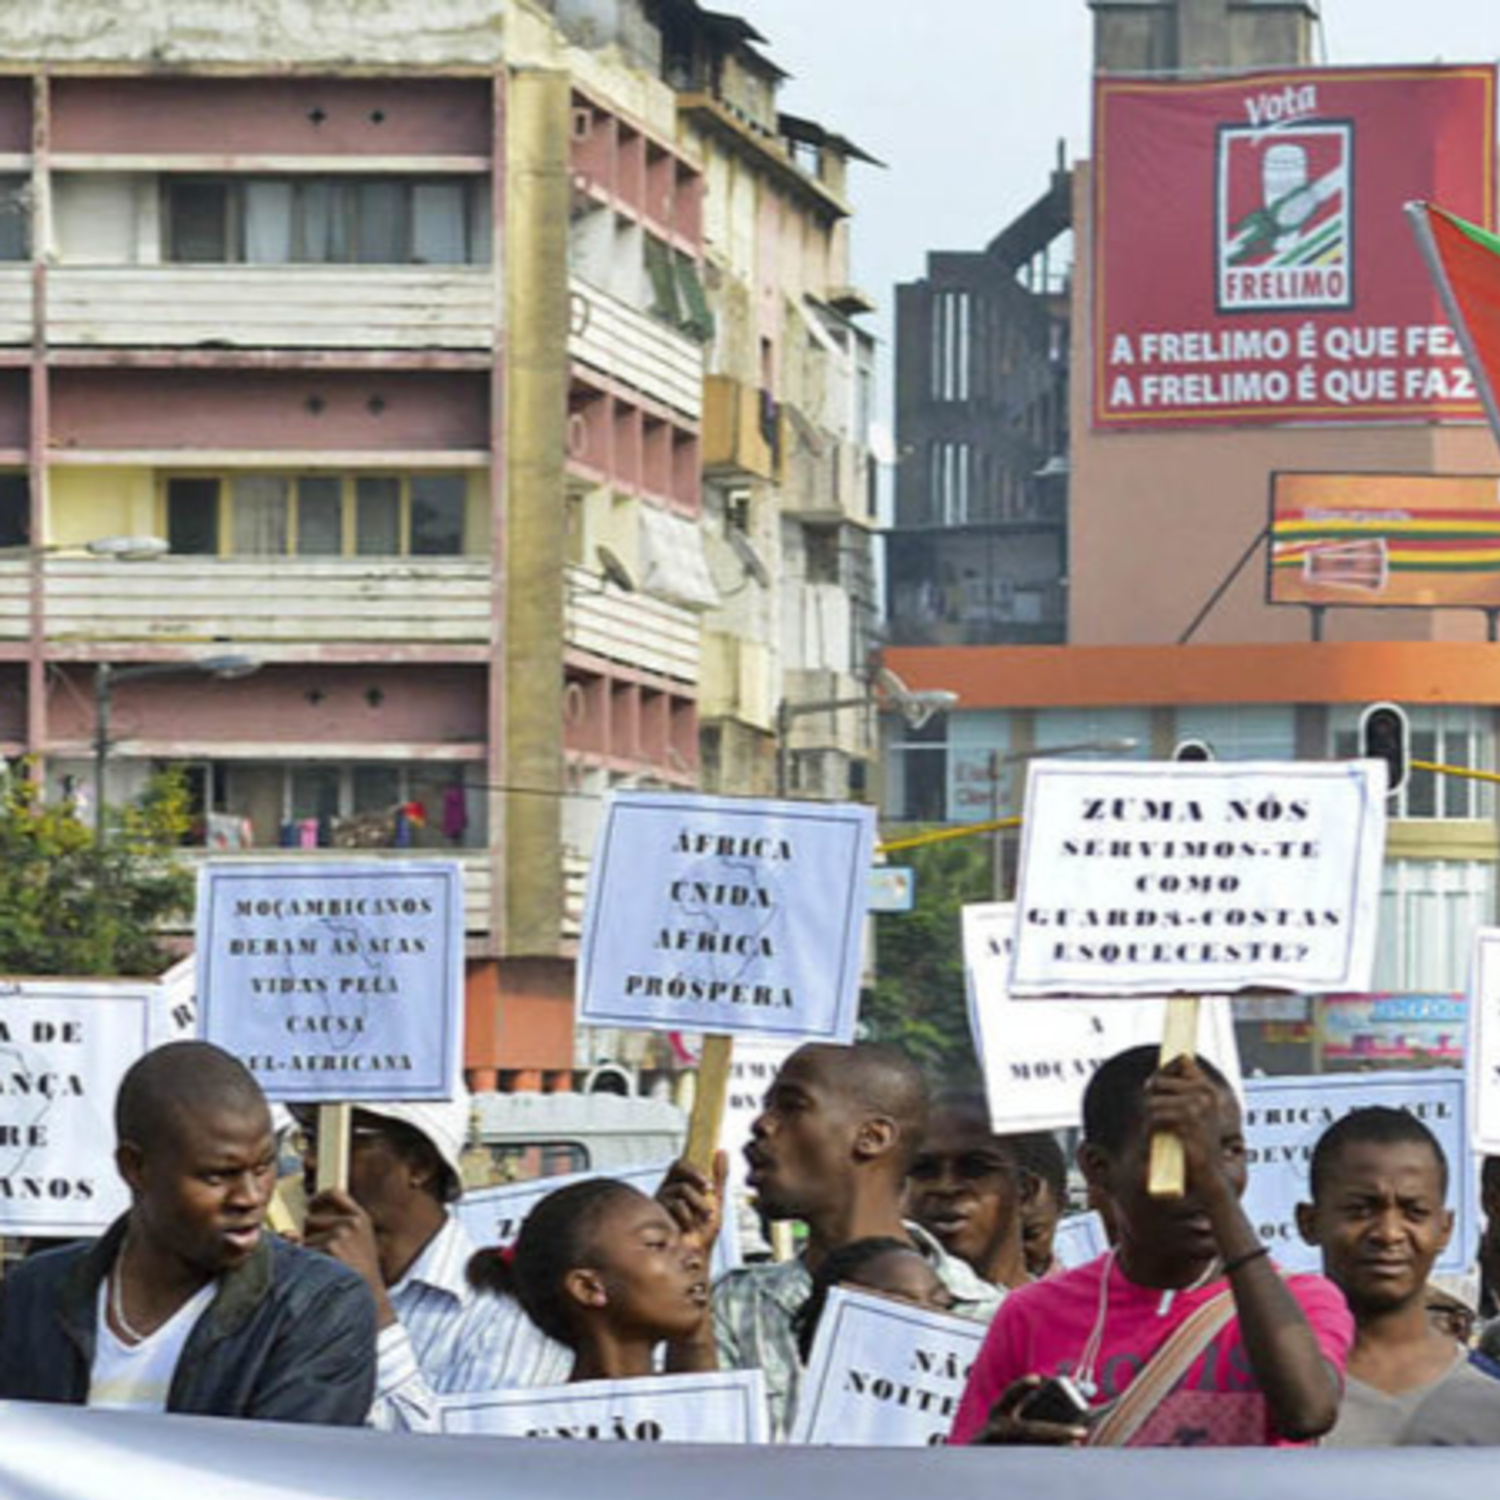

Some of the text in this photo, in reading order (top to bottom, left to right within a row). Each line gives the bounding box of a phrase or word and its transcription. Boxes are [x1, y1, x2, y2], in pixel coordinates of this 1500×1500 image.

[1244, 85, 1316, 125] Vota
[1226, 271, 1344, 300] FRELIMO
[1111, 335, 1134, 363] A
[1141, 329, 1290, 363] FRELIMO
[1298, 323, 1317, 358] É
[1324, 328, 1397, 362] QUE
[1111, 365, 1476, 406] A FRELIMO É QUE FAZ
[1082, 797, 1203, 822] ZUMA
[1062, 840, 1320, 860] SERVIMOS-TE
[670, 879, 774, 909] UNIDA
[1135, 875, 1240, 894] COMO
[234, 898, 433, 920] MOÇAMBICANOS
[229, 938, 317, 956] DERAM
[251, 976, 399, 994] VIDAS PELA
[624, 972, 793, 1008] PRÓSPERA
[33, 1021, 82, 1044] DE
[286, 1016, 365, 1034] CAUSA
[0, 1072, 84, 1100] NÇA
